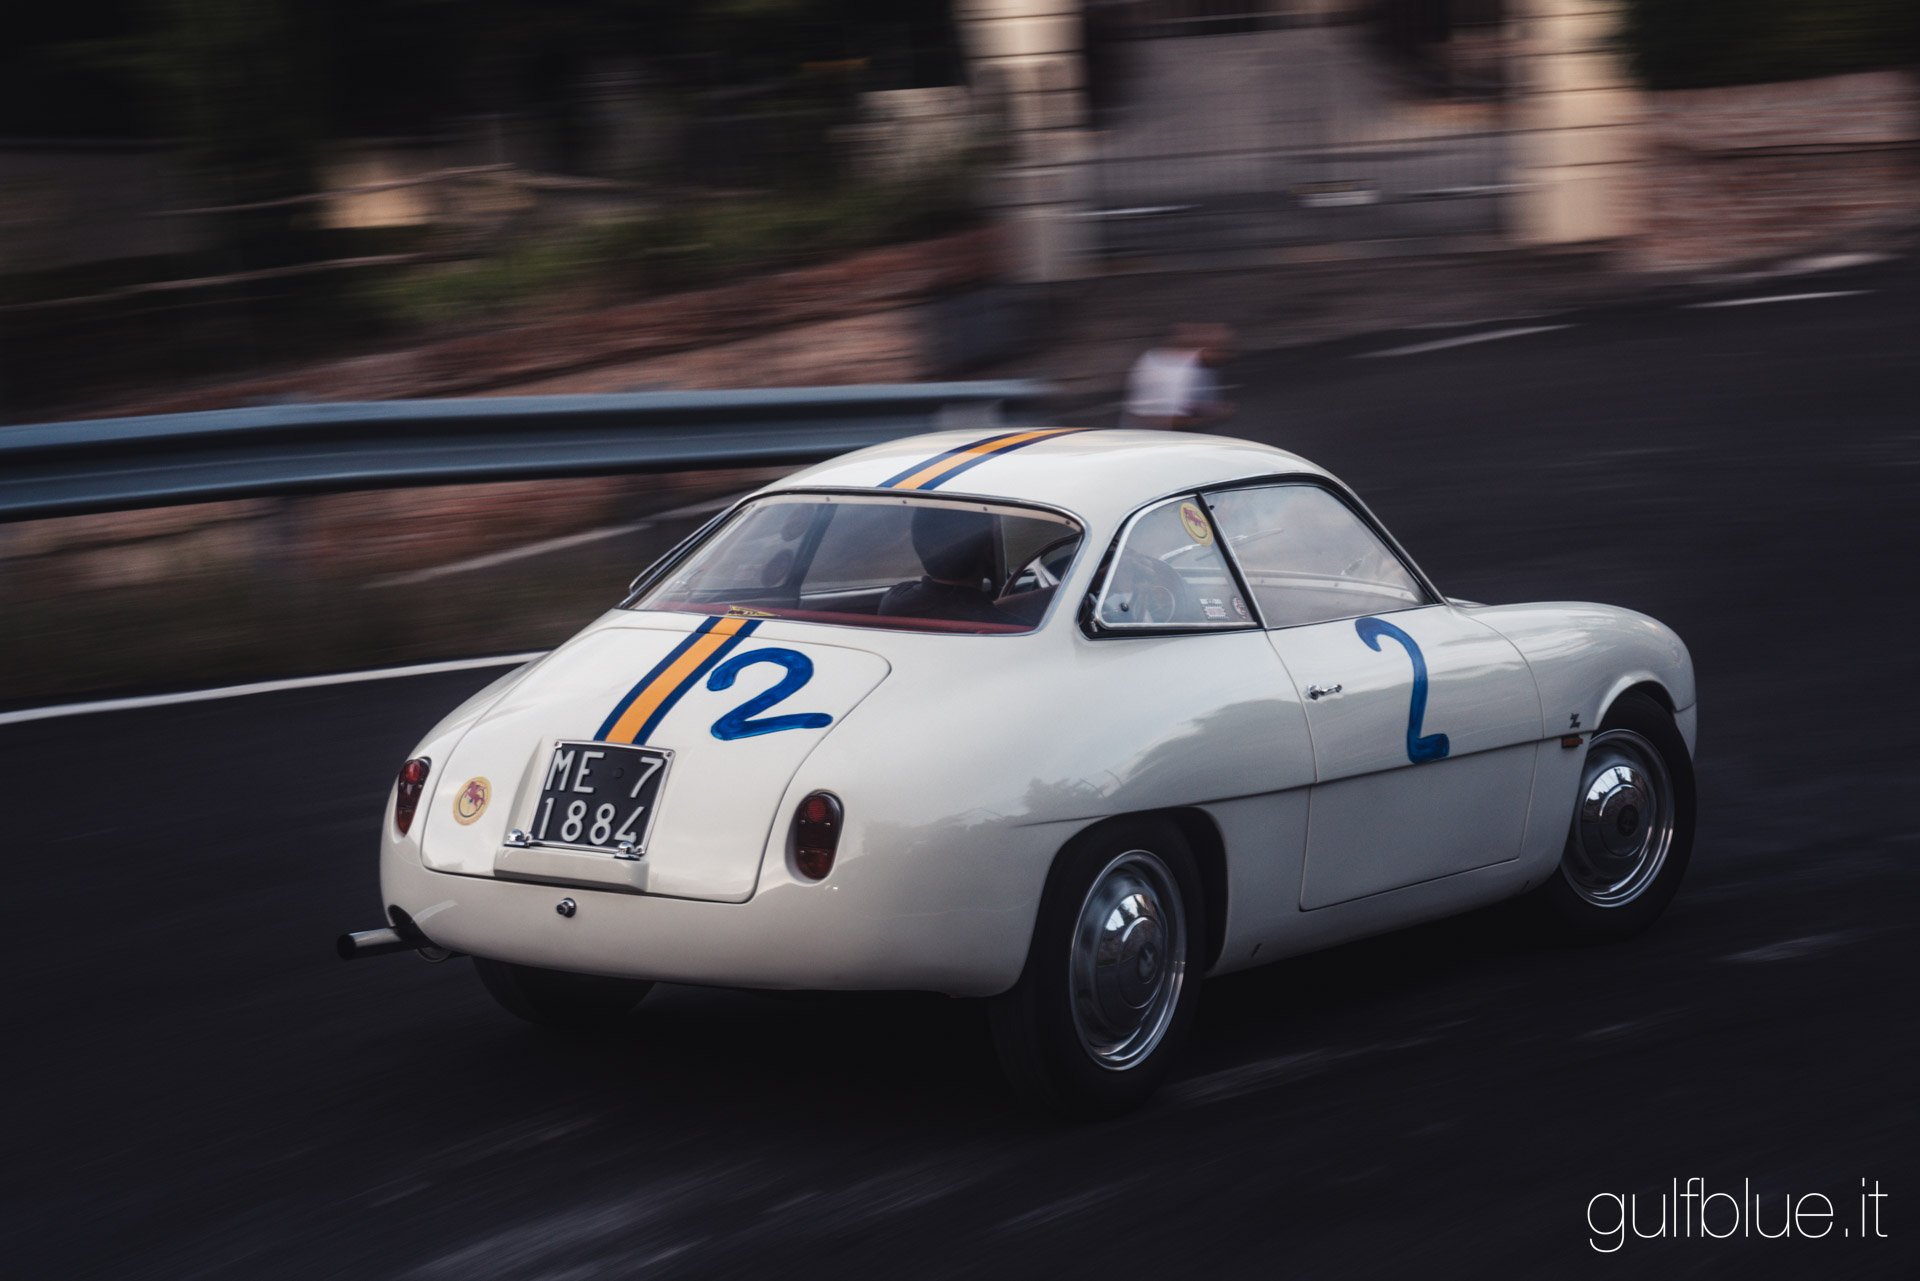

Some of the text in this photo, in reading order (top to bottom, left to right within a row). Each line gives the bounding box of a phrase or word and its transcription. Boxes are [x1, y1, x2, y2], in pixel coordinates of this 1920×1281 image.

[706, 647, 834, 741] 2
[1355, 617, 1450, 764] 2
[545, 750, 664, 798] ME 7
[538, 797, 645, 845] 1884
